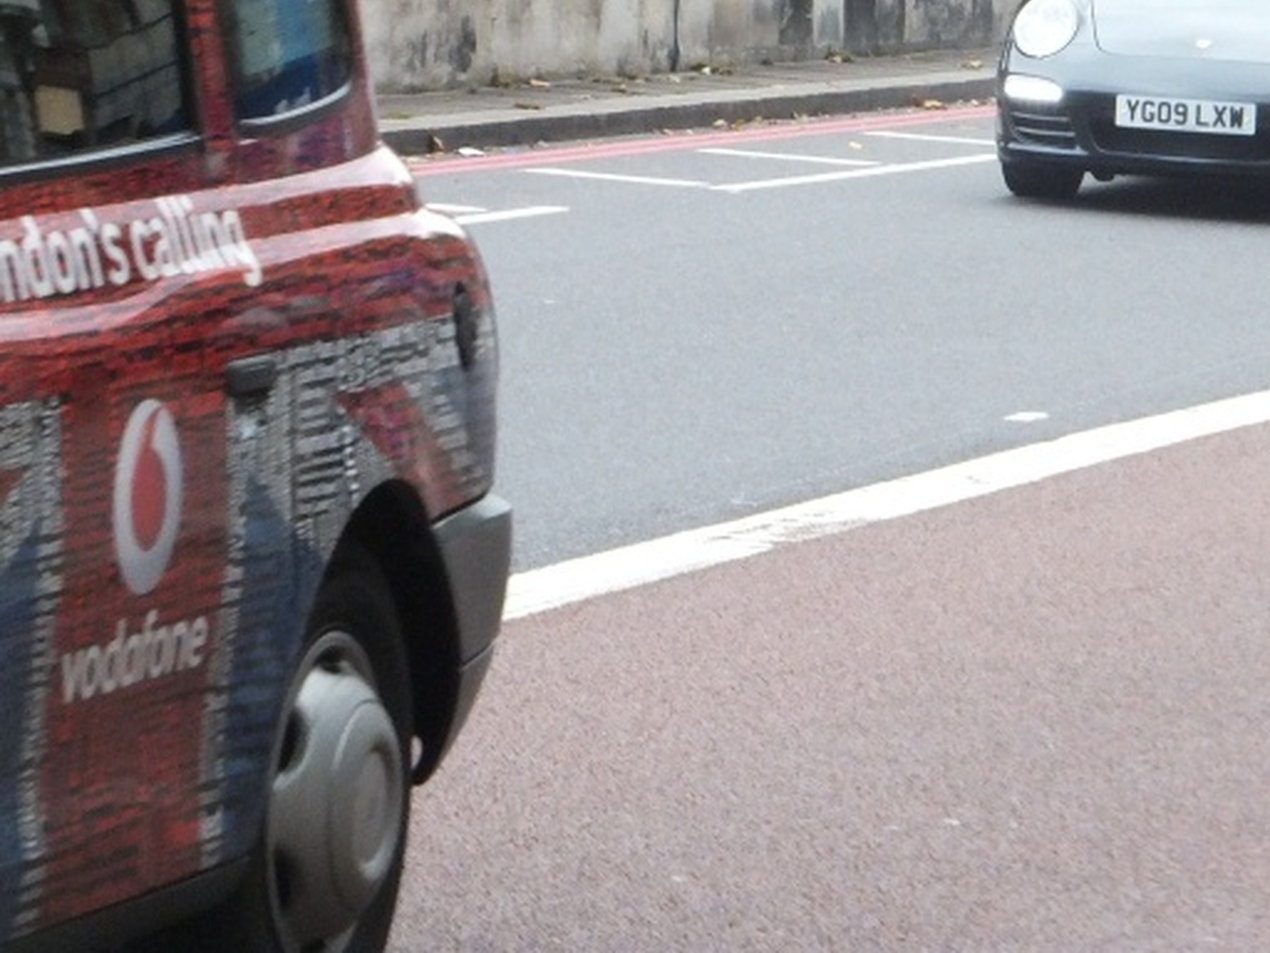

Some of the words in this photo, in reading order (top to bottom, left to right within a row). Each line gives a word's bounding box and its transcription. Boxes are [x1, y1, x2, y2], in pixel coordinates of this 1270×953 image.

[1126, 99, 1188, 126] YG09
[1195, 103, 1245, 129] LXW
[130, 194, 263, 288] calling
[62, 608, 209, 705] vodafone
